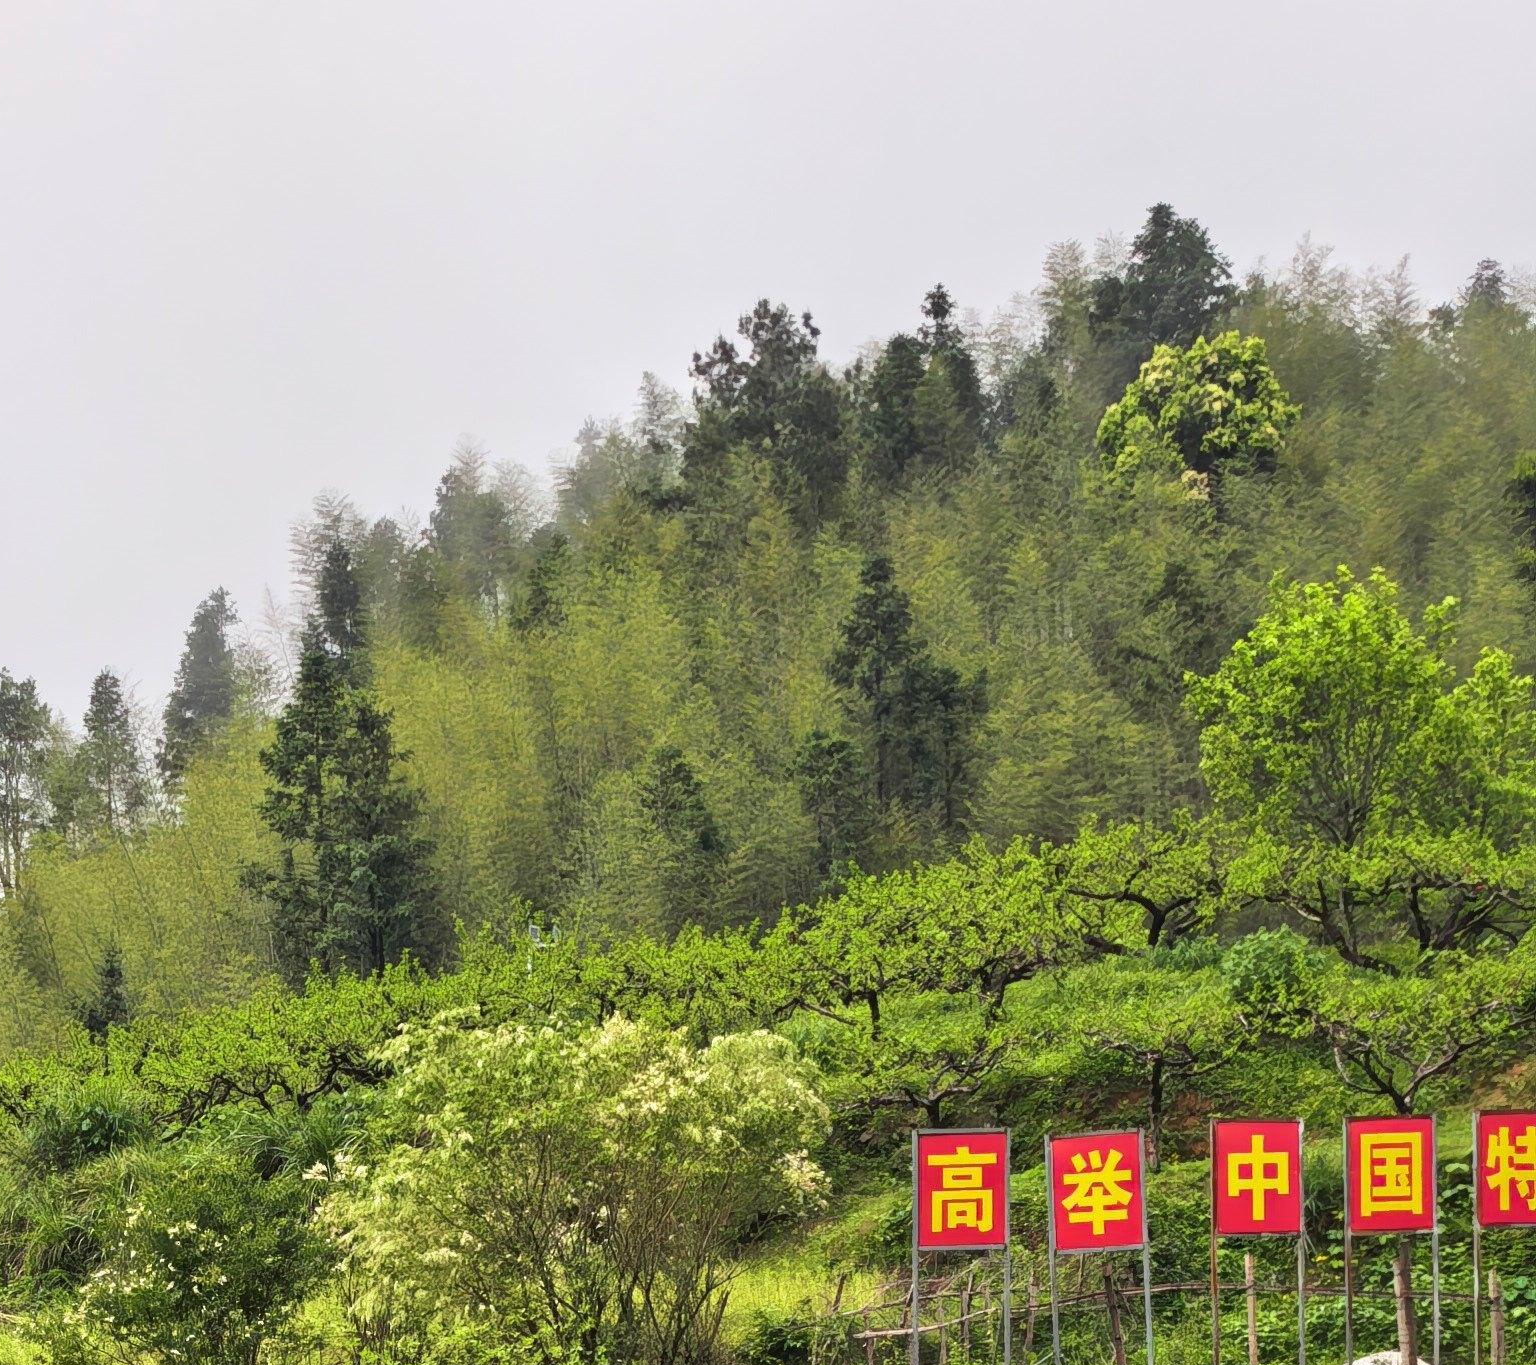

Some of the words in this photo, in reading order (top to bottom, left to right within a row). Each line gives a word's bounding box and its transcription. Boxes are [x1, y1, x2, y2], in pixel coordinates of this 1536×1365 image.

[927, 1126, 1536, 1236] 高举中国特
